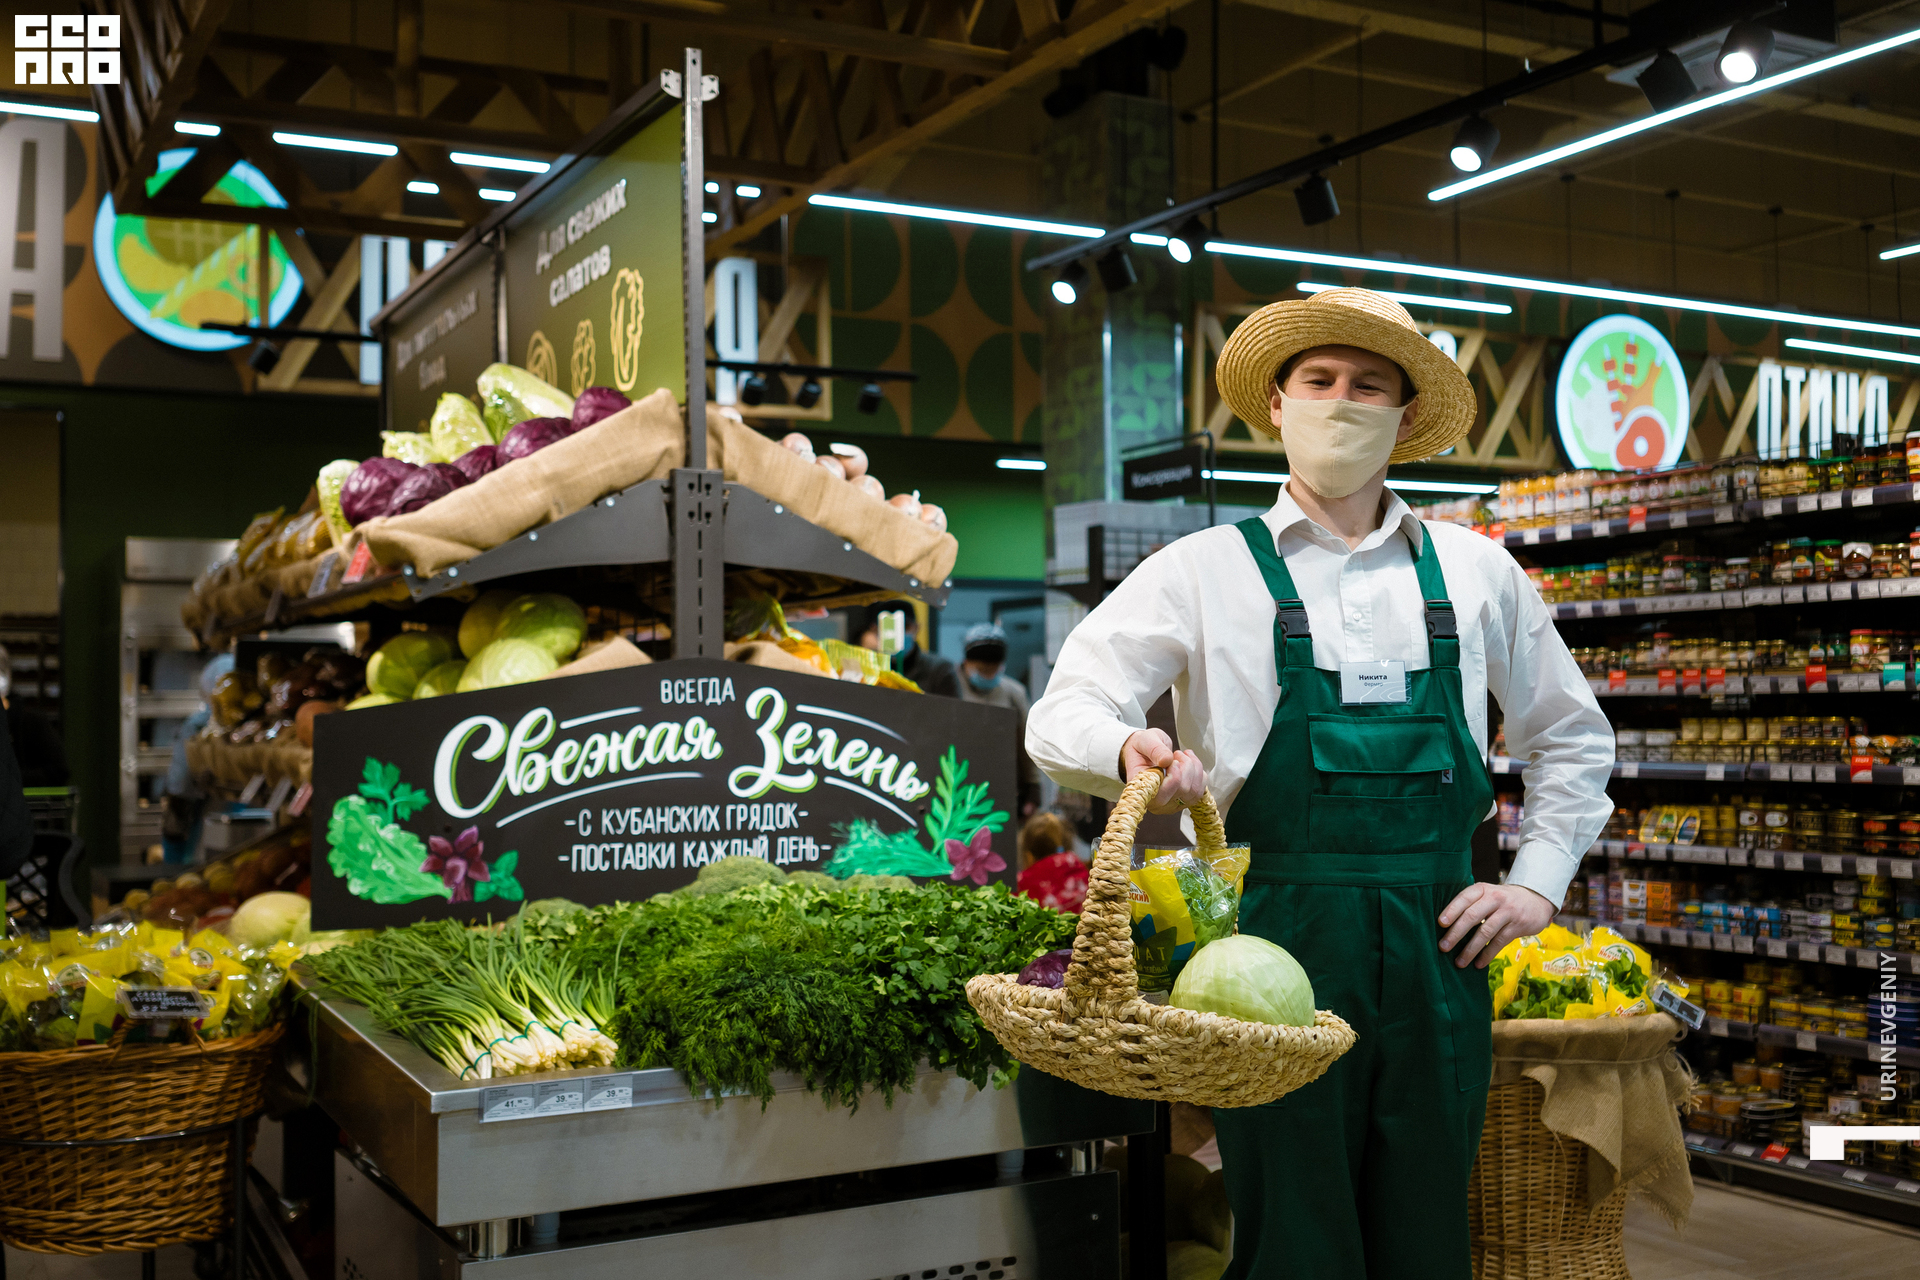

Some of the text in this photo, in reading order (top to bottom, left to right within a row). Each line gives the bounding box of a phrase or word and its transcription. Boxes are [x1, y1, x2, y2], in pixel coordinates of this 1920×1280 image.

[549, 245, 611, 307] салатов
[660, 677, 736, 706] ВСЕГДА
[433, 686, 931, 819] Свежая Зелень
[601, 805, 720, 836] КУБАНСКИХ
[1133, 945, 1165, 961] ЛАТ
